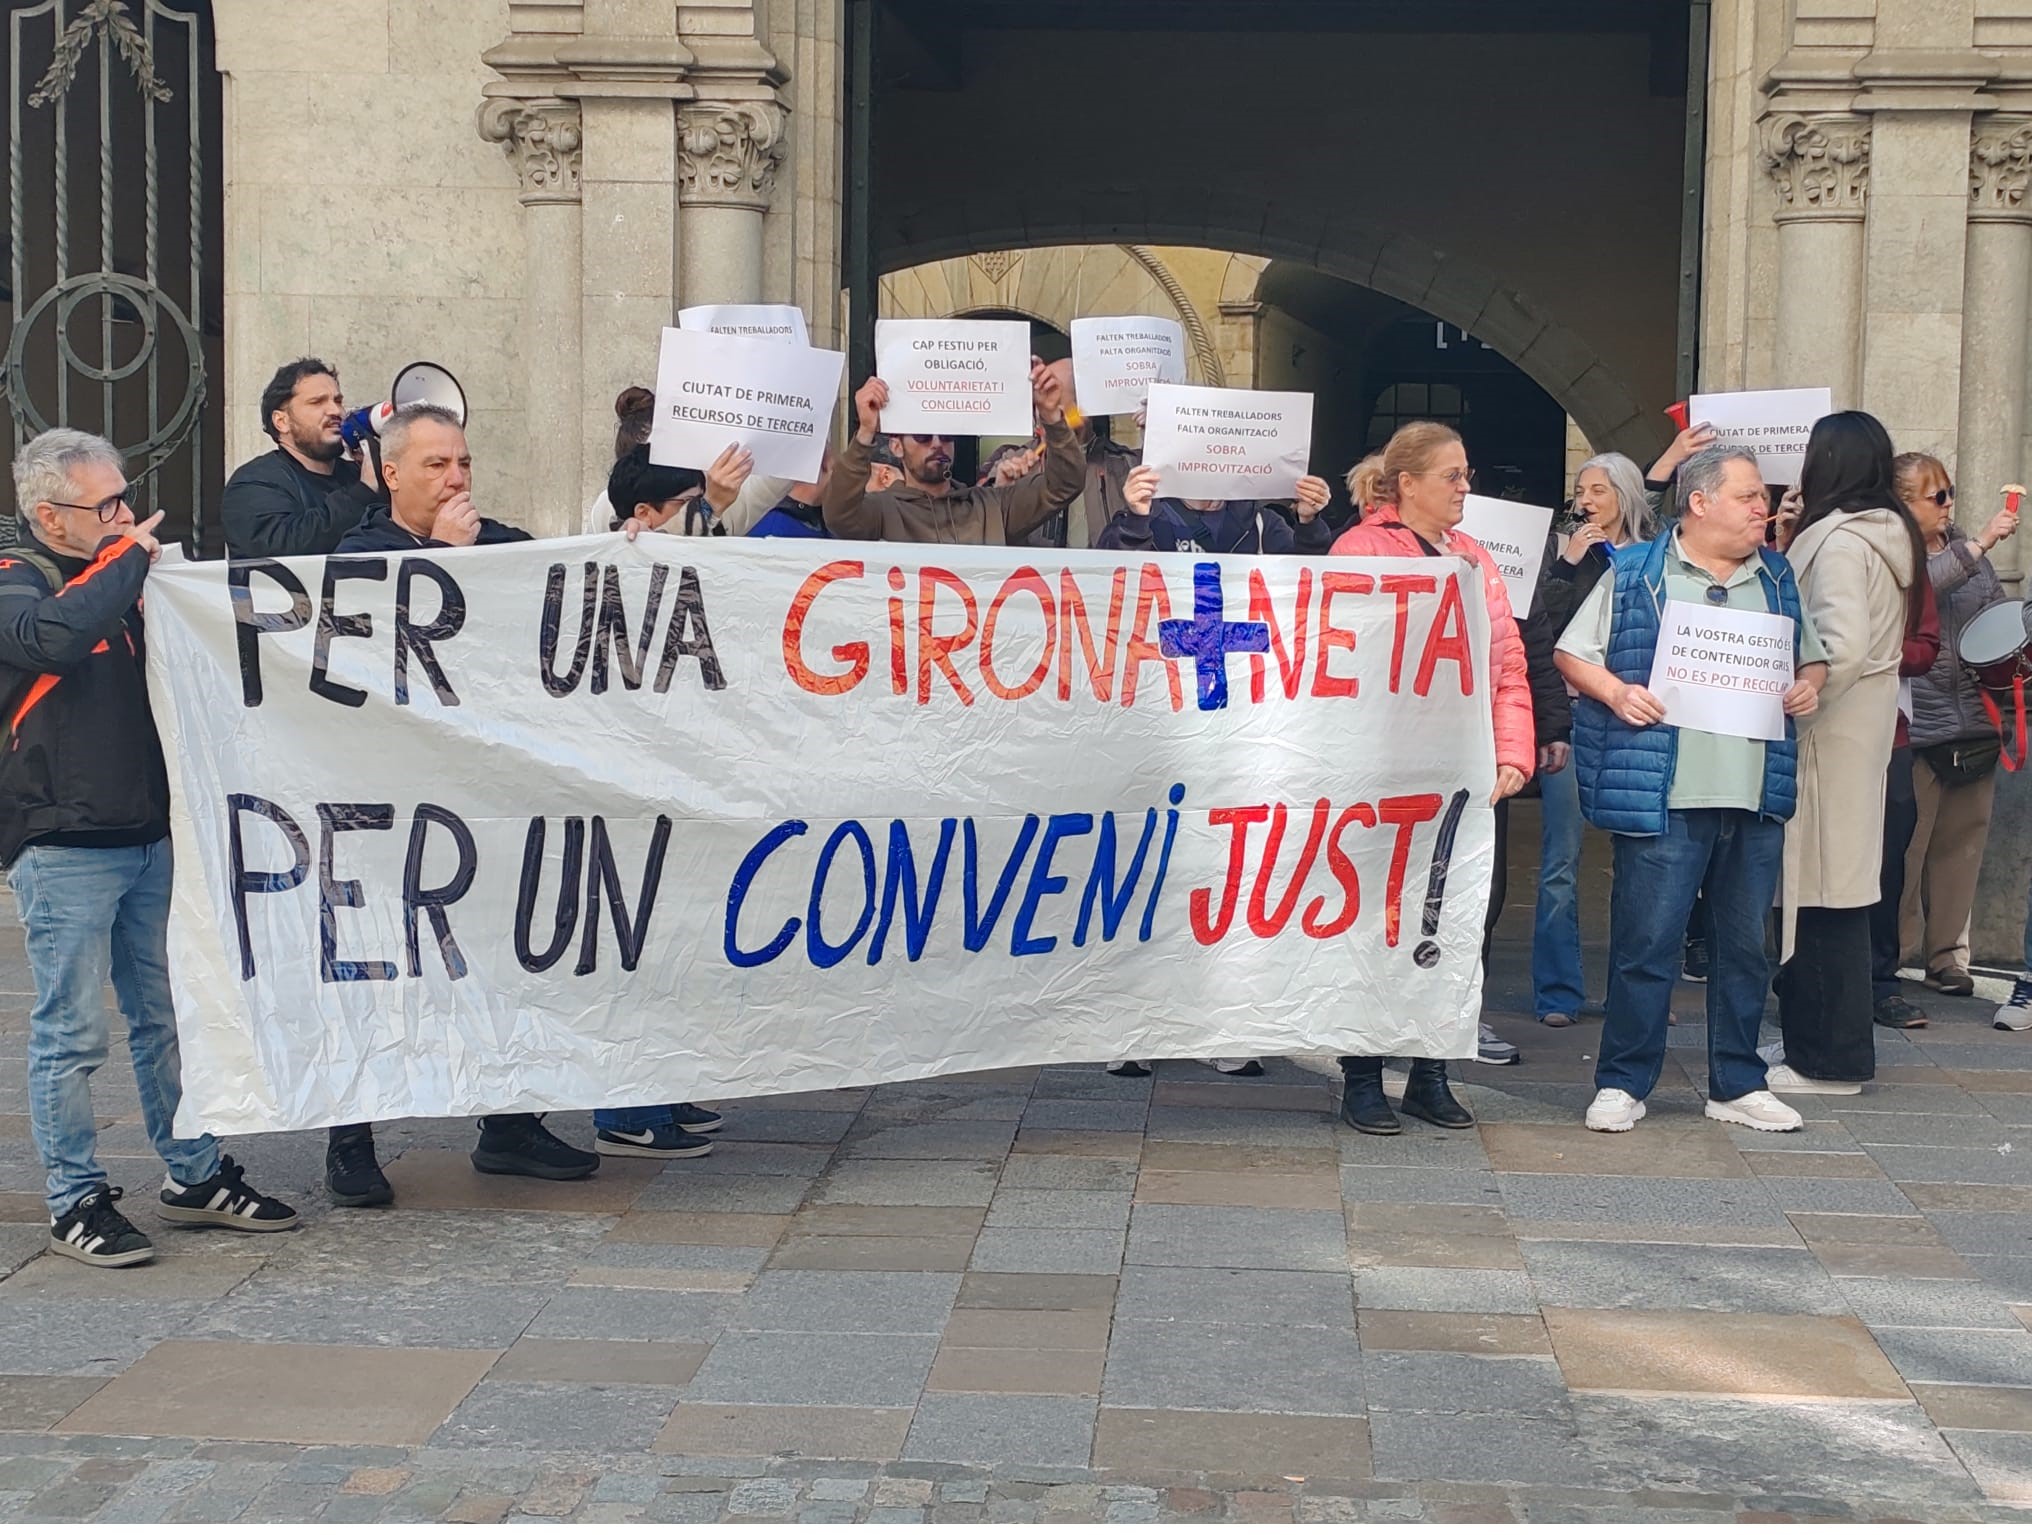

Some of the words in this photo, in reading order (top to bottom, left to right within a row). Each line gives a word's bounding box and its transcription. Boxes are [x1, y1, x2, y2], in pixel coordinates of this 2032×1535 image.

[1096, 334, 1124, 343] FALTEN
[912, 340, 934, 350] CAP
[938, 341, 974, 351] FESTIU
[978, 342, 998, 352] PER
[1100, 347, 1124, 356] FALTA
[924, 358, 988, 372] OBLIGACIÓ,
[1126, 362, 1157, 371] SOBRA
[907, 380, 998, 392] VOLUNTARIETAT
[682, 381, 732, 398] CIUTAT
[735, 387, 752, 400] DE
[757, 390, 814, 412] PRIMERA,
[921, 400, 991, 410] CONCILIACIÓ
[672, 405, 742, 424] RECURSOS
[747, 414, 763, 428] DE
[767, 418, 814, 434] TERCERA
[1176, 406, 1208, 416] FALTEN
[1212, 410, 1282, 420] TREBALLADORS
[1178, 424, 1205, 434] FALTA
[1208, 426, 1278, 438] ORGANITZACIÓ
[1748, 427, 1760, 436] DE
[1206, 444, 1246, 456] SOBRA
[1759, 444, 1772, 453] DE
[1178, 462, 1272, 475] IMPROVITZACIÓ
[227, 556, 466, 707] PER
[539, 561, 727, 699] UNA
[1677, 625, 1690, 637] LA
[1695, 628, 1744, 645] VOSTRA
[1748, 635, 1783, 650] GESTIÓ
[1672, 646, 1687, 658] DE
[1690, 648, 1770, 669] CONTENIDOR
[1666, 666, 1688, 680] NO
[1692, 670, 1707, 682] ES
[1711, 673, 1740, 687] POT
[226, 792, 478, 983] PER
[513, 813, 673, 977] UN
